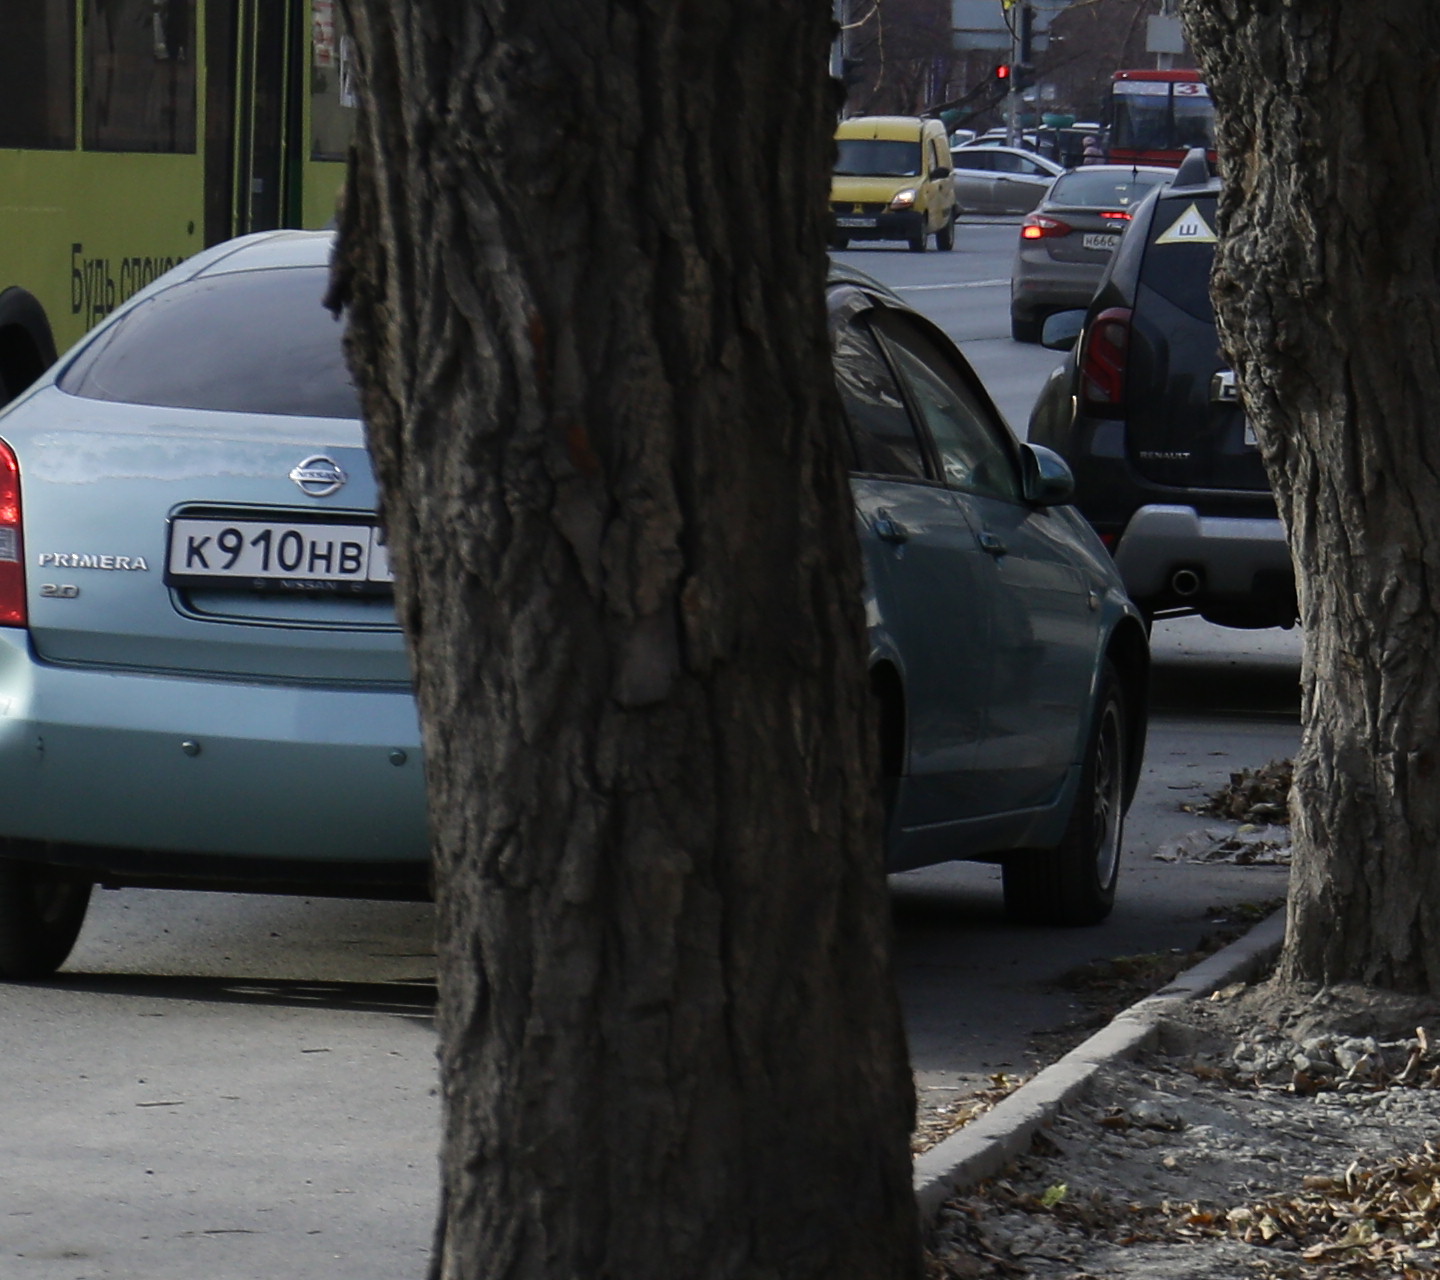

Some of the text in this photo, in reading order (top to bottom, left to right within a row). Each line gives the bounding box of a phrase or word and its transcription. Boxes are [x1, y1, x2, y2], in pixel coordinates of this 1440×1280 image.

[1178, 223, 1199, 237] Ш
[71, 243, 115, 331] Будь
[38, 552, 149, 572] PRIMERA
[185, 527, 364, 575] К910НВ
